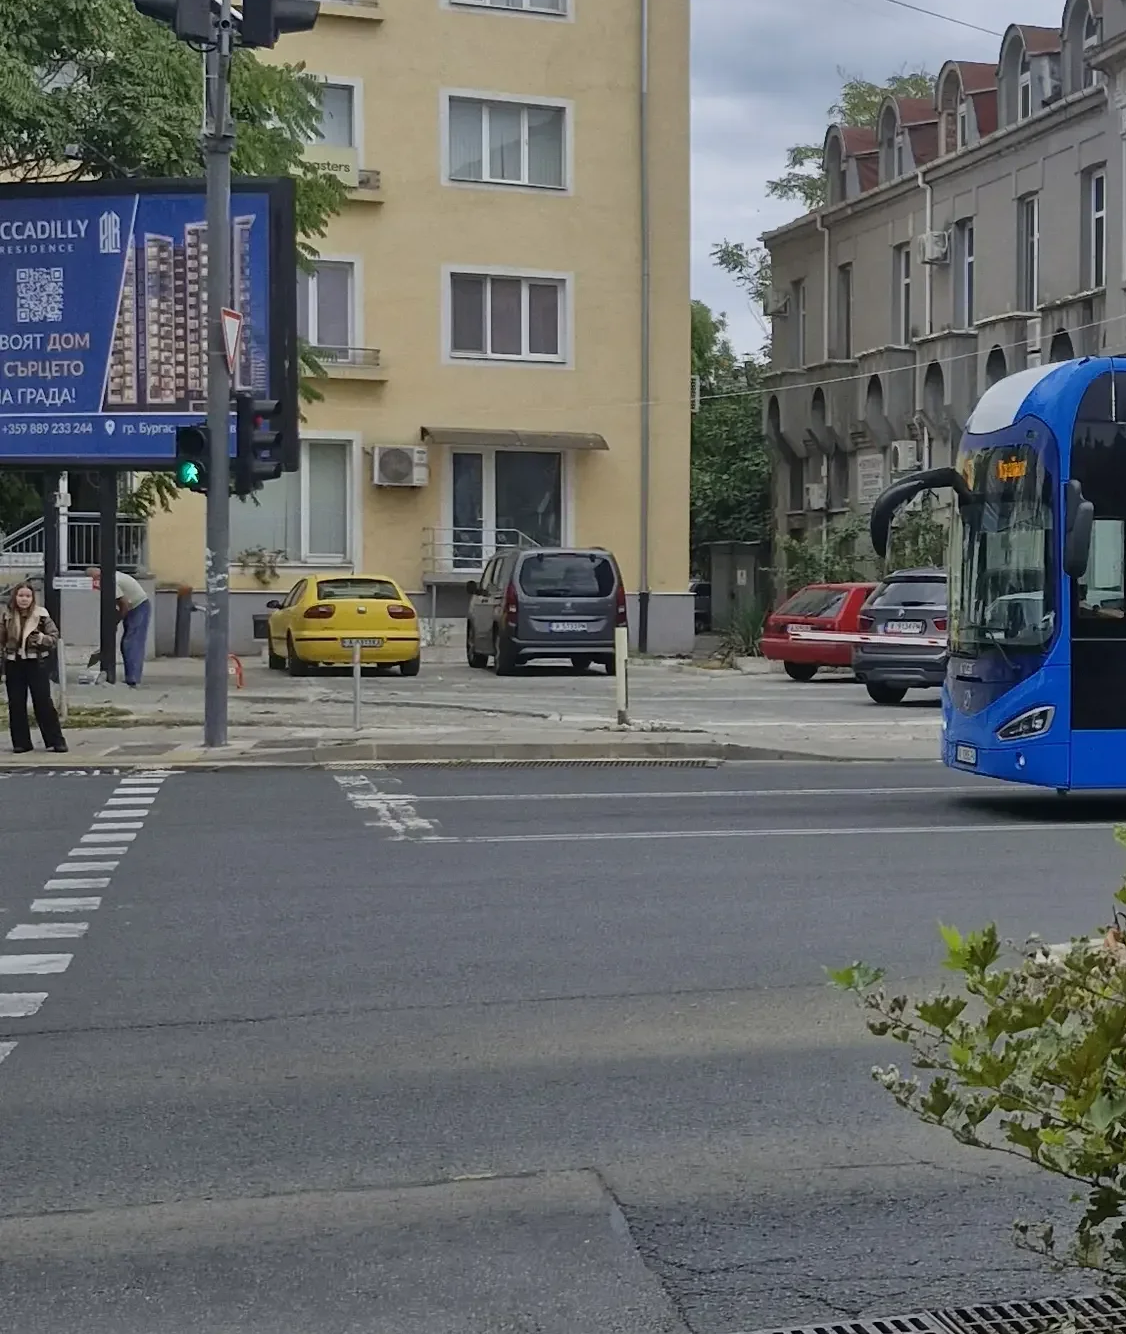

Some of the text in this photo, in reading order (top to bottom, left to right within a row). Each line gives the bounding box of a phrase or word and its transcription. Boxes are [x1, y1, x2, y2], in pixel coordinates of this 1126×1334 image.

[0, 332, 90, 352] ВОЯТ ДОМ
[4, 360, 84, 380] СЪРЦЕТО
[17, 388, 76, 407] ГРАДА!
[2, 422, 93, 435] +359 889 233 244
